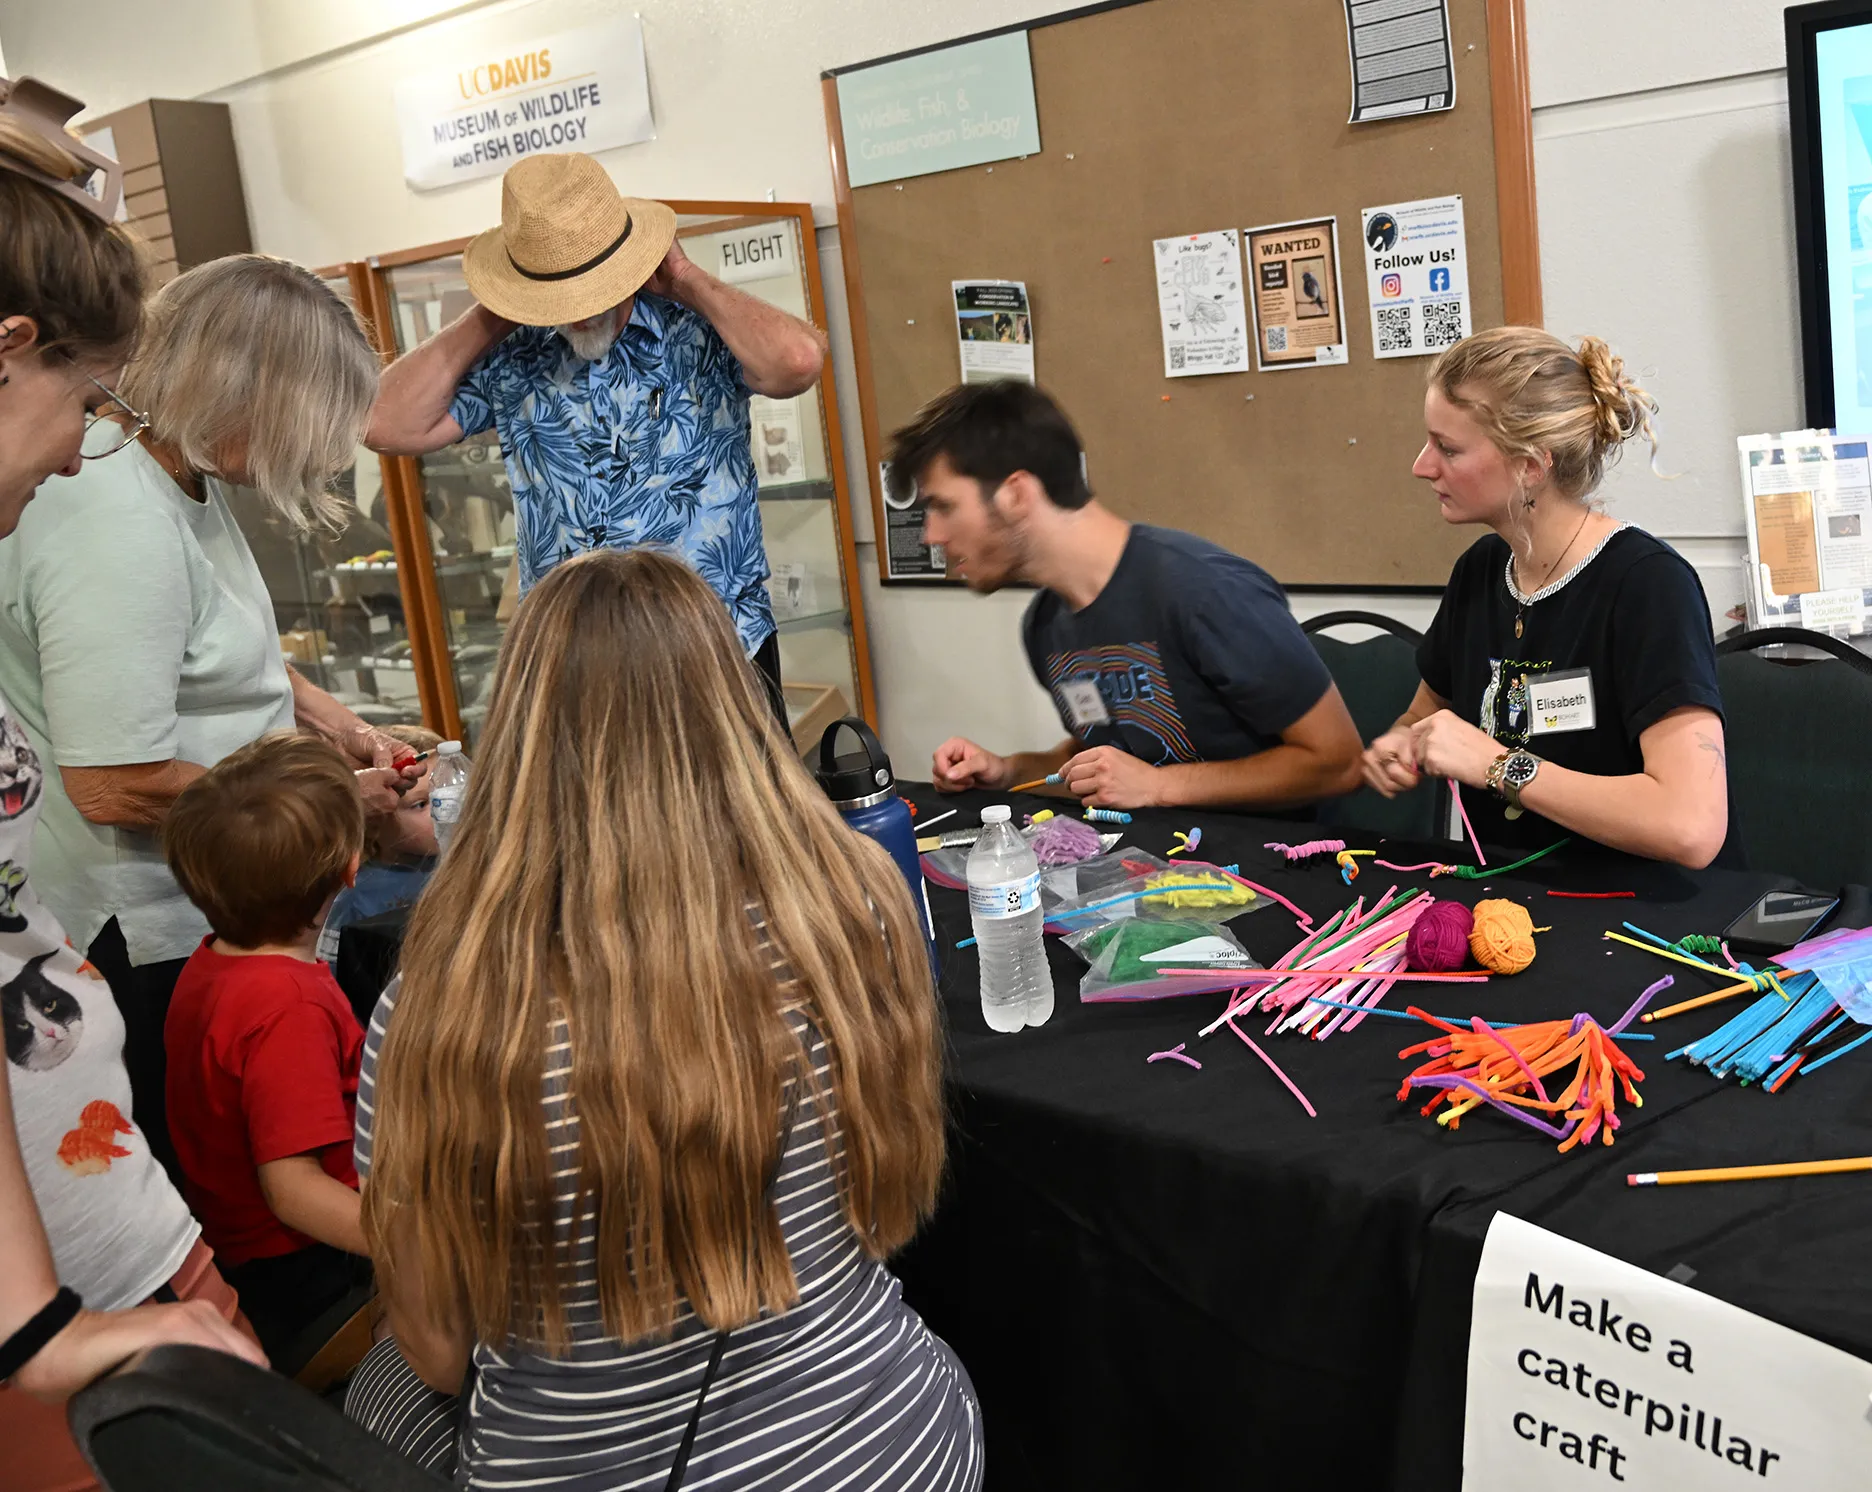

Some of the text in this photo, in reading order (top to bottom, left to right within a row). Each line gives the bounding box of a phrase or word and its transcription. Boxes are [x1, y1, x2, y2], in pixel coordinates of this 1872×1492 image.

[433, 109, 500, 144] MUSEUM
[520, 83, 601, 122] WILDLIFE
[453, 117, 587, 168] AND FISH BIOLOGY
[860, 111, 1021, 160] Conservation Biology
[722, 234, 783, 267] FLIGHT
[1261, 237, 1321, 256] WANTED
[1374, 248, 1455, 270] Follow Us!
[1806, 594, 1859, 606] PLEASE HELP
[1813, 605, 1854, 616] YOURSELF
[1536, 694, 1587, 711] Elisabeth
[1524, 1272, 1694, 1374] Make a
[1517, 1348, 1780, 1478] caterpillar
[1513, 1410, 1627, 1482] craft
